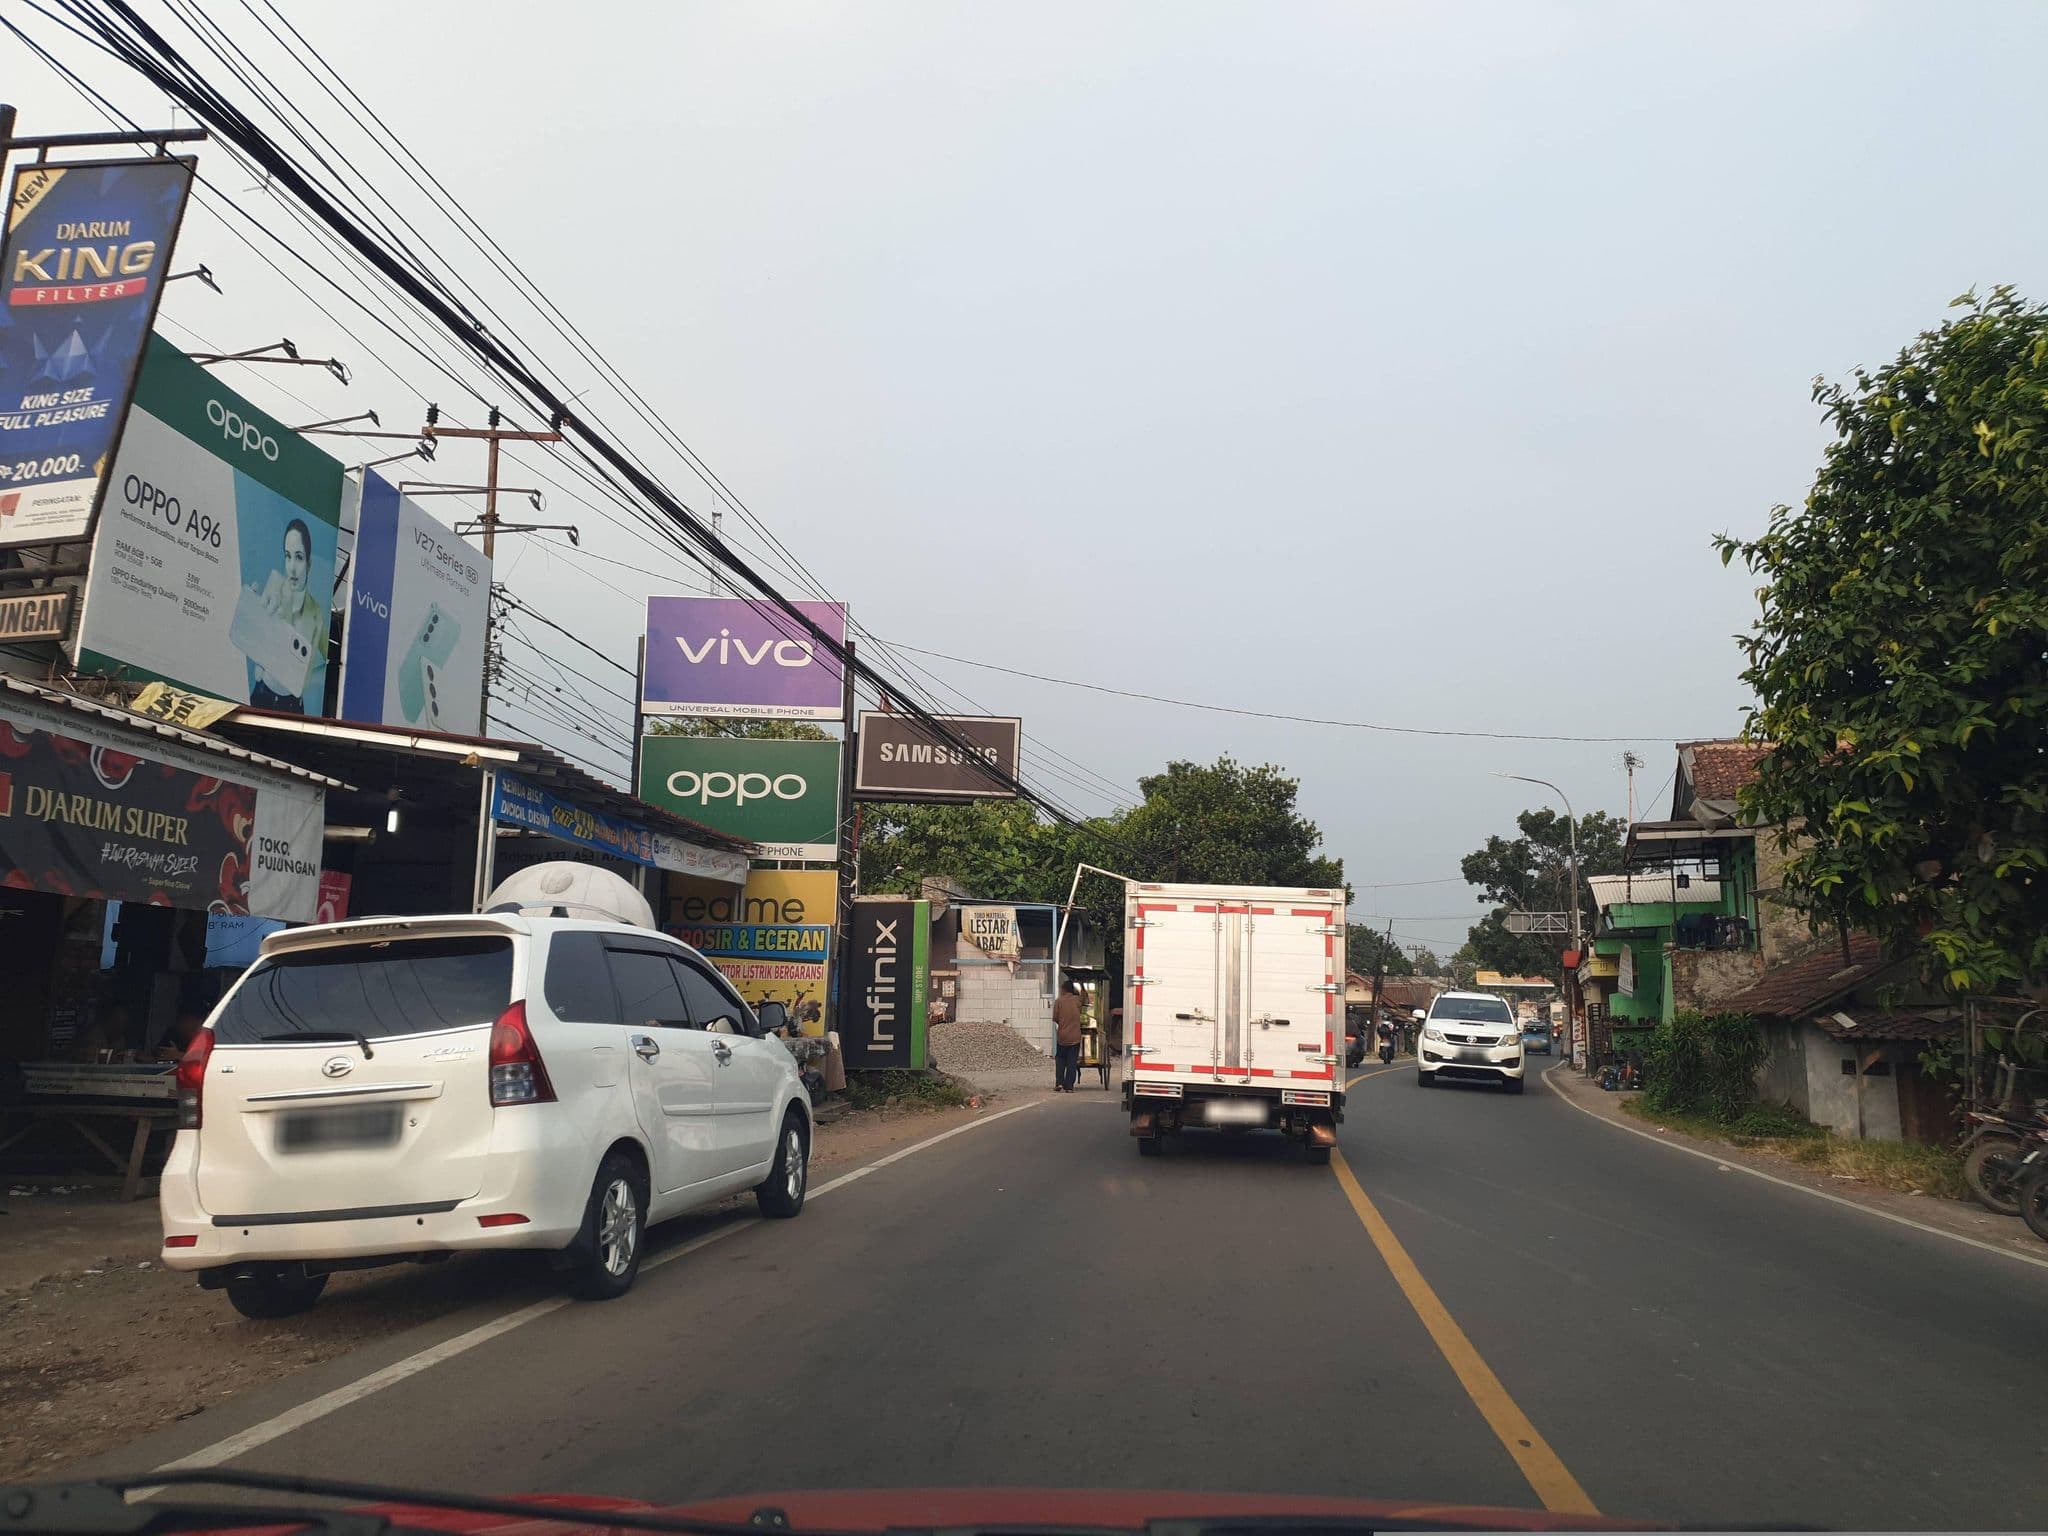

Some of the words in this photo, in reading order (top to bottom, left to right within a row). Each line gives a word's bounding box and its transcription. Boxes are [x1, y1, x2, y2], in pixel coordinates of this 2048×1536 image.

[16, 171, 50, 210] NEW
[56, 221, 131, 240] DJARUM
[13, 241, 157, 282] KING
[36, 284, 126, 302] FILTER
[20, 393, 60, 410] KING
[61, 386, 96, 405] SIZE
[34, 403, 110, 428] PLEASURE
[206, 399, 280, 462] oppo
[123, 473, 182, 526] OPPO
[185, 508, 223, 549] A96
[414, 527, 435, 552] V27
[436, 544, 464, 575] Series
[356, 589, 389, 620] vivo
[675, 628, 815, 667] vivo
[669, 703, 730, 714] UNIVERSAL
[732, 706, 773, 715] MOBILE
[775, 707, 815, 716] PHONE
[666, 770, 807, 807] oppo
[25, 786, 121, 833] DJARUM
[124, 806, 189, 845] SUPER
[767, 846, 804, 857] PHONE
[258, 855, 316, 877] PULUNGAN
[737, 929, 750, 951] &
[753, 929, 826, 952] ECERAN
[970, 919, 1010, 934] LESTARI
[743, 965, 772, 980] LISTRIK
[774, 965, 824, 981] BERGARANSI
[867, 919, 898, 1052] Infinix
